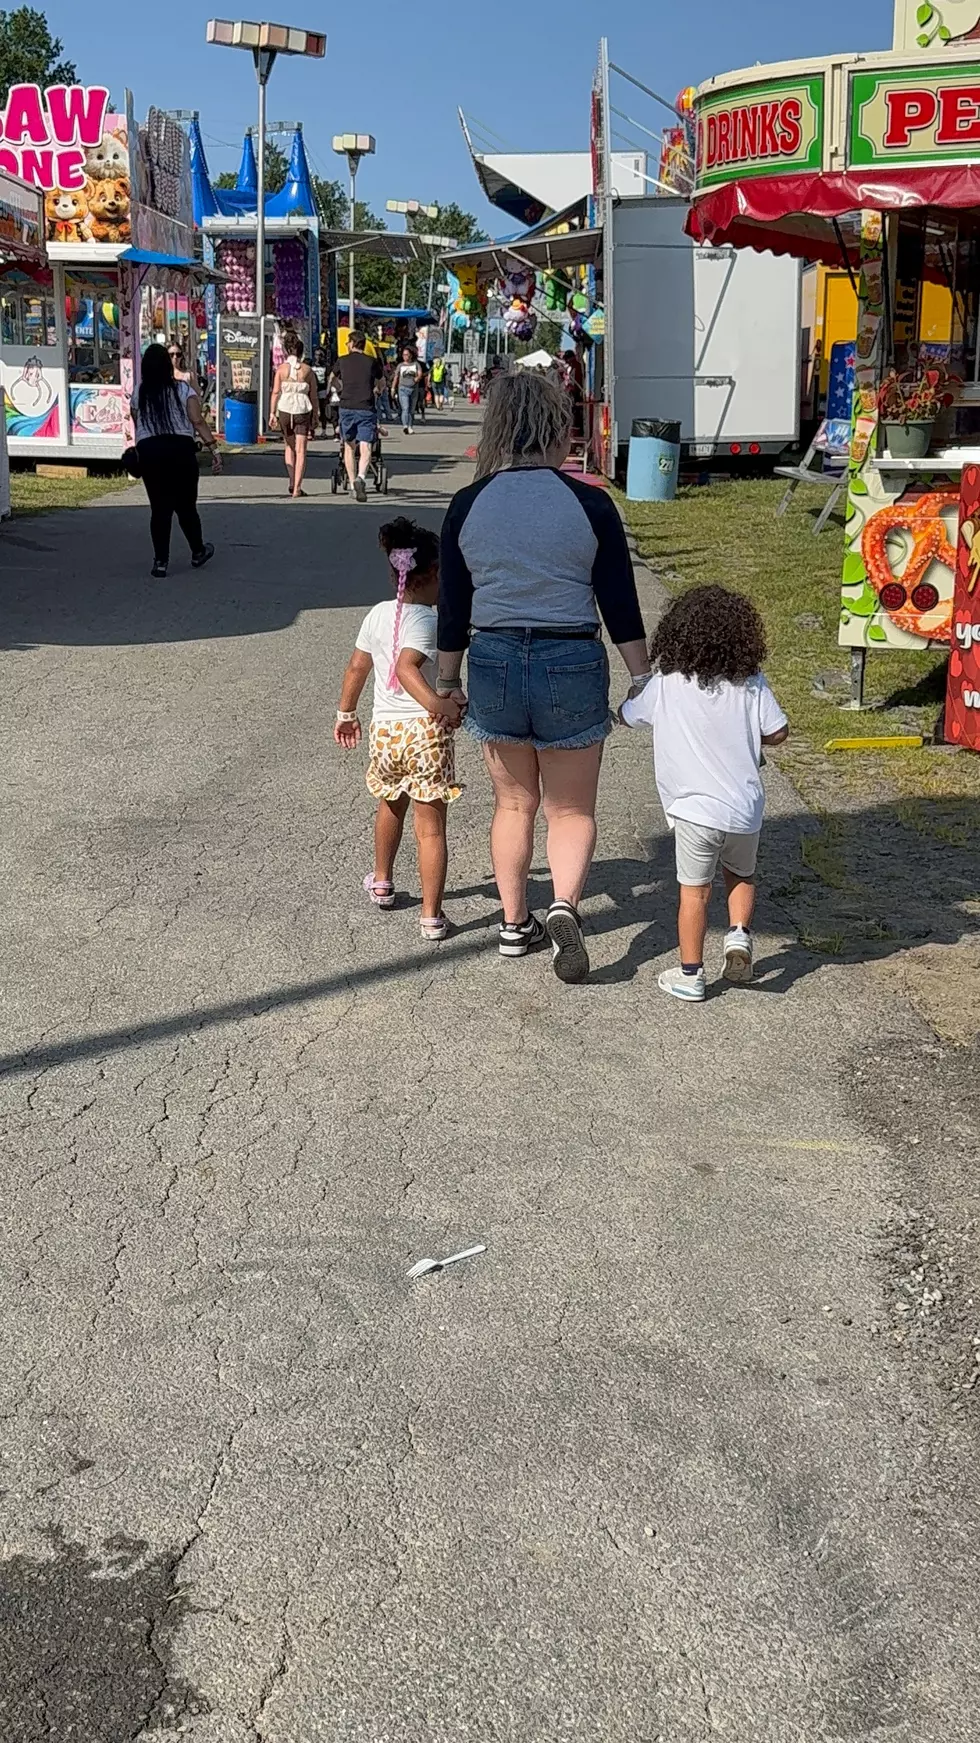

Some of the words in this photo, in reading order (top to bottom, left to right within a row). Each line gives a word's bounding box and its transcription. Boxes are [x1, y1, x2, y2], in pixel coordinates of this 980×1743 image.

[0, 84, 109, 147] AW
[706, 97, 802, 168] DRINKS
[883, 86, 980, 148] PE
[222, 328, 258, 348] Disney
